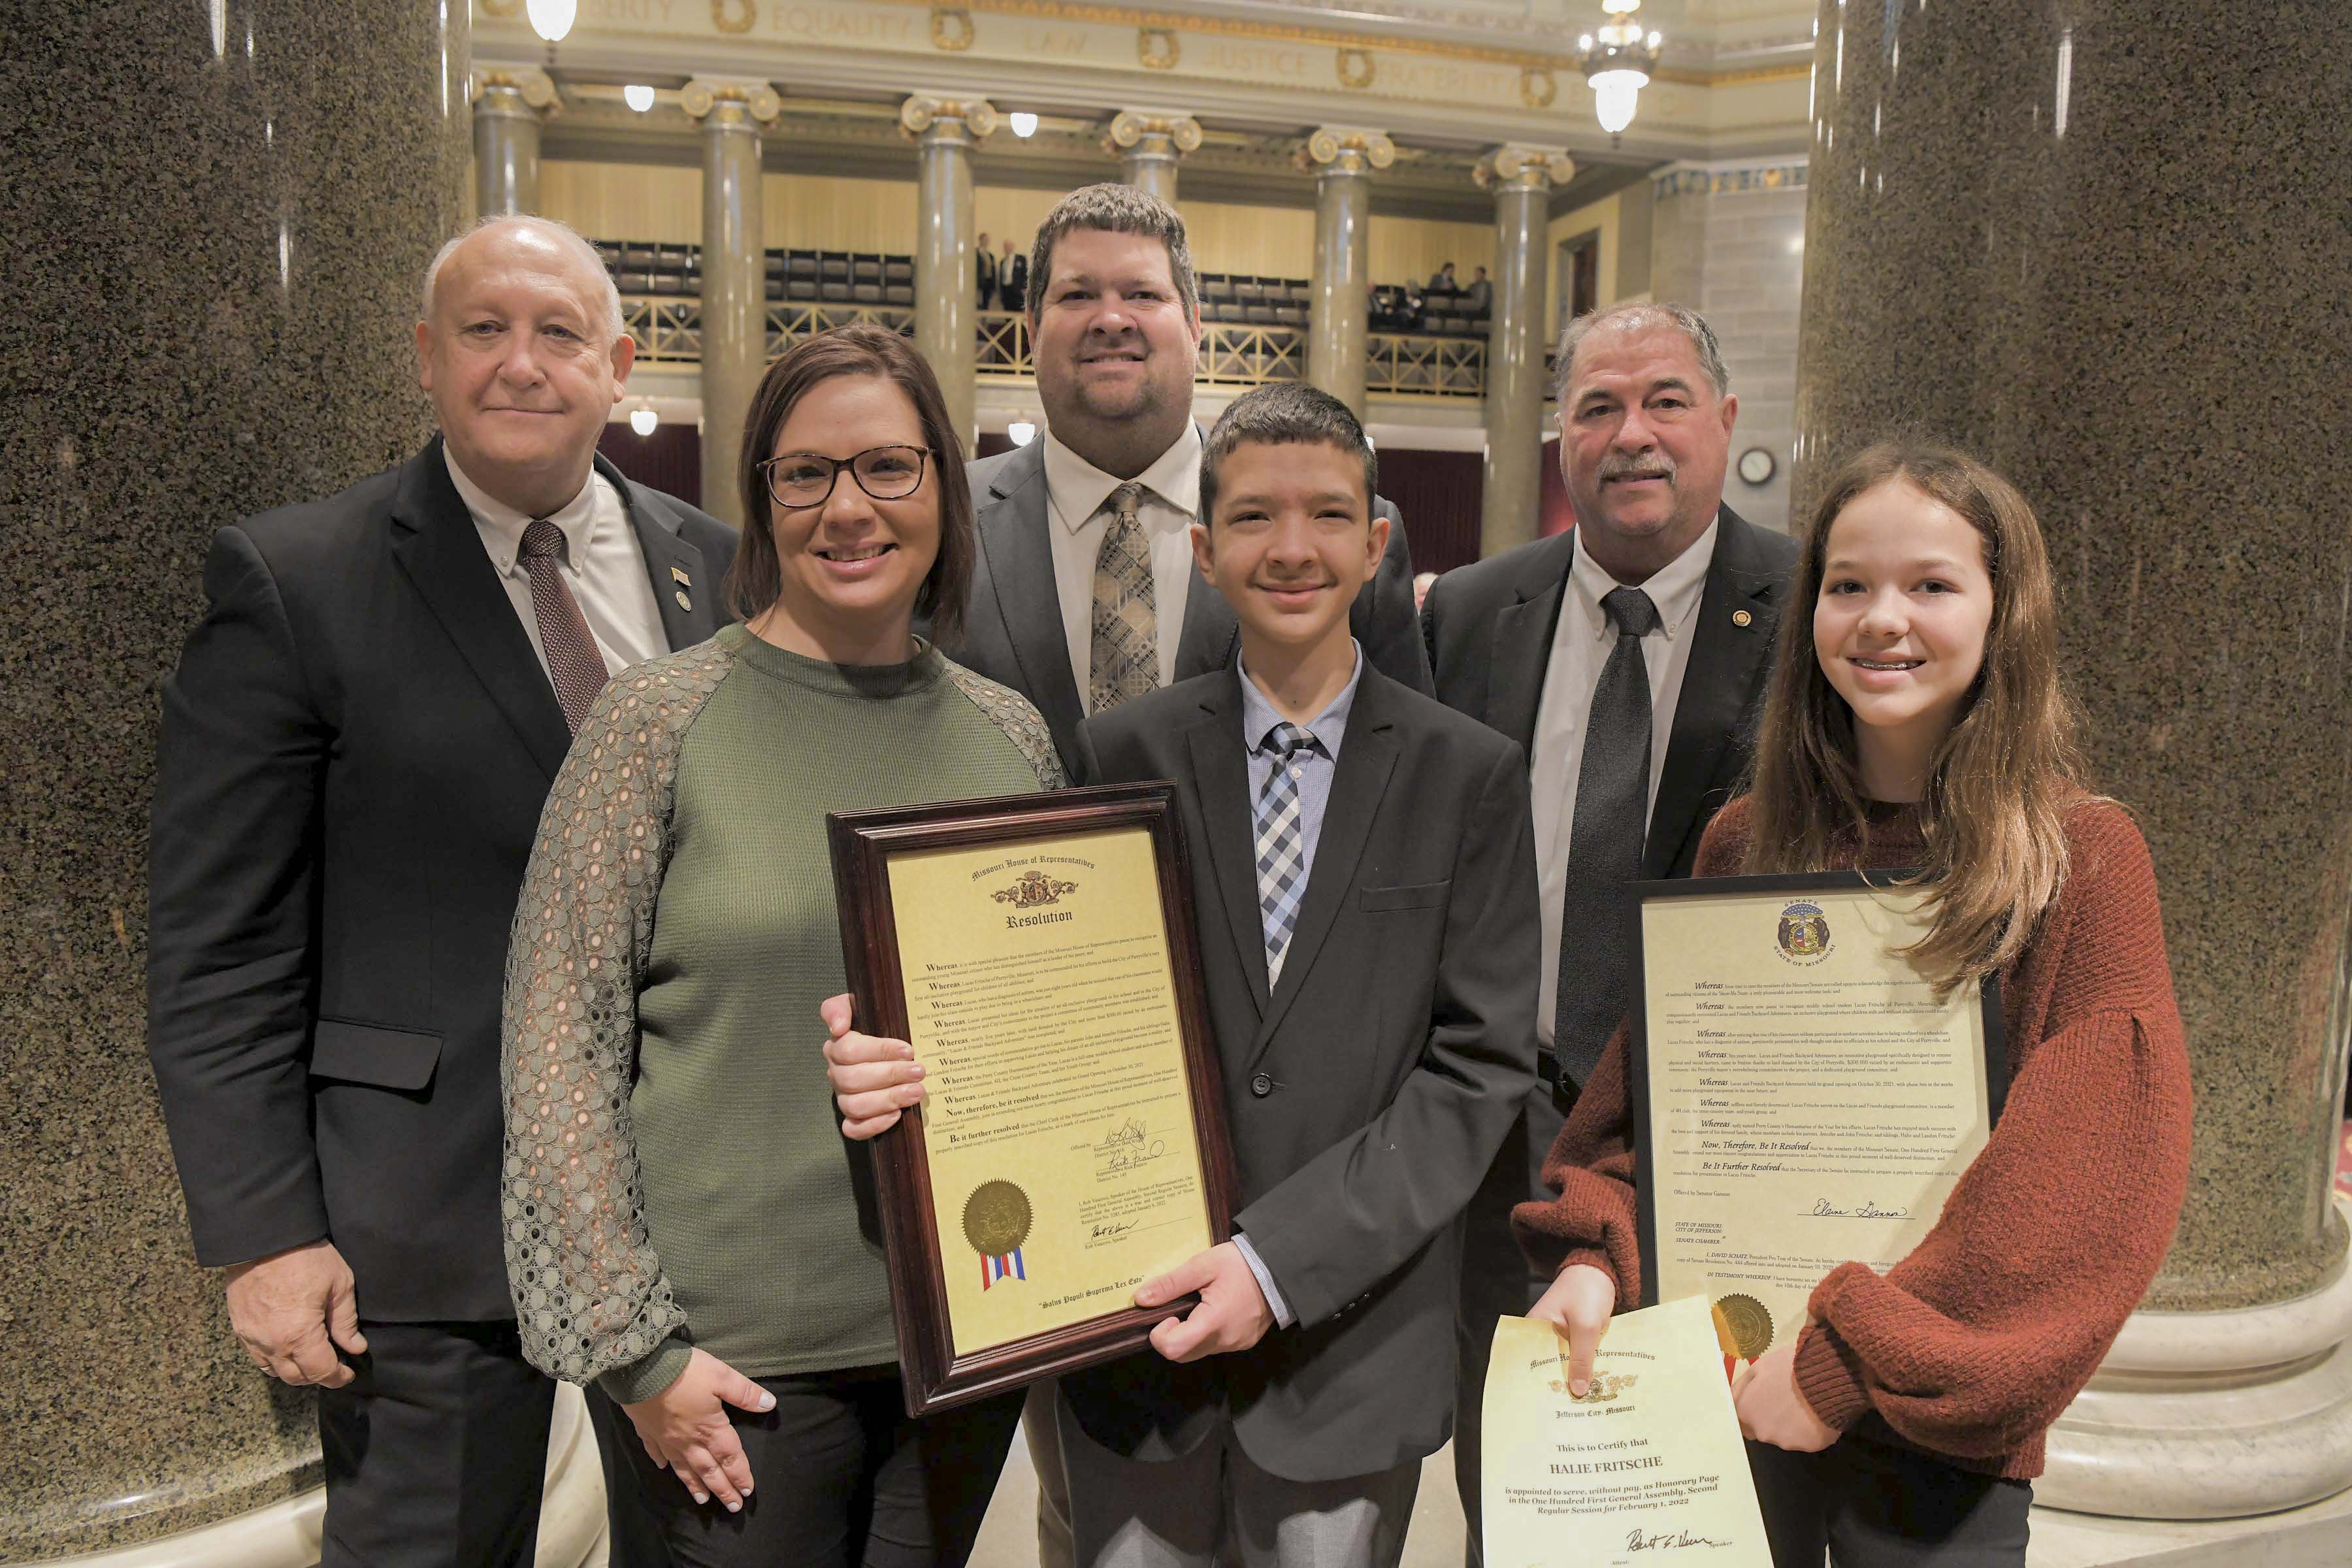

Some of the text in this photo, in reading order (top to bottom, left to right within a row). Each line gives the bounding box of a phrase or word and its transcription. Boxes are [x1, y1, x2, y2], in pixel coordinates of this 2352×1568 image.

[771, 5, 912, 42] EQUALITY
[1024, 29, 1088, 55] LAW
[1203, 42, 1307, 76] JUSTICE
[972, 864, 1004, 882] Missouri
[1005, 859, 1028, 868] House
[1039, 855, 1095, 869] Representatives
[1784, 899, 1819, 907] SENATE
[1005, 909, 1072, 928] Resolution
[1773, 945, 1791, 963] STATE
[1805, 944, 1836, 967] MISSOURI
[945, 1108, 965, 1117] Now,
[966, 1103, 998, 1113] therefore,
[1013, 1093, 1039, 1104] resolved
[949, 1134, 960, 1143] Be
[968, 1130, 991, 1139] further
[993, 1122, 1019, 1134] resolved
[1723, 1139, 1757, 1152] Therefore,
[1778, 1141, 1810, 1150] Resolved
[1722, 1161, 1749, 1169] Further
[1750, 1162, 1782, 1171] Resolved
[1063, 1292, 1084, 1304] Populi
[1085, 1285, 1113, 1297] Suprema
[1530, 1357, 1558, 1369] Missouri
[1595, 1349, 1656, 1360] Representatives
[1605, 1405, 1635, 1416] Missouri
[1557, 1444, 1576, 1452] This
[1598, 1440, 1627, 1450] Certify
[1630, 1438, 1648, 1446] that
[1550, 1456, 1663, 1474] HALIE FRITSCHE
[1513, 1488, 1552, 1496] appointed
[1655, 1478, 1697, 1489] Honorary
[1699, 1475, 1720, 1484] Page
[1609, 1493, 1641, 1503] General
[1688, 1483, 1718, 1494] Second
[1538, 1507, 1569, 1515] Regular
[1603, 1505, 1617, 1514] for
[1619, 1502, 1658, 1512] February
